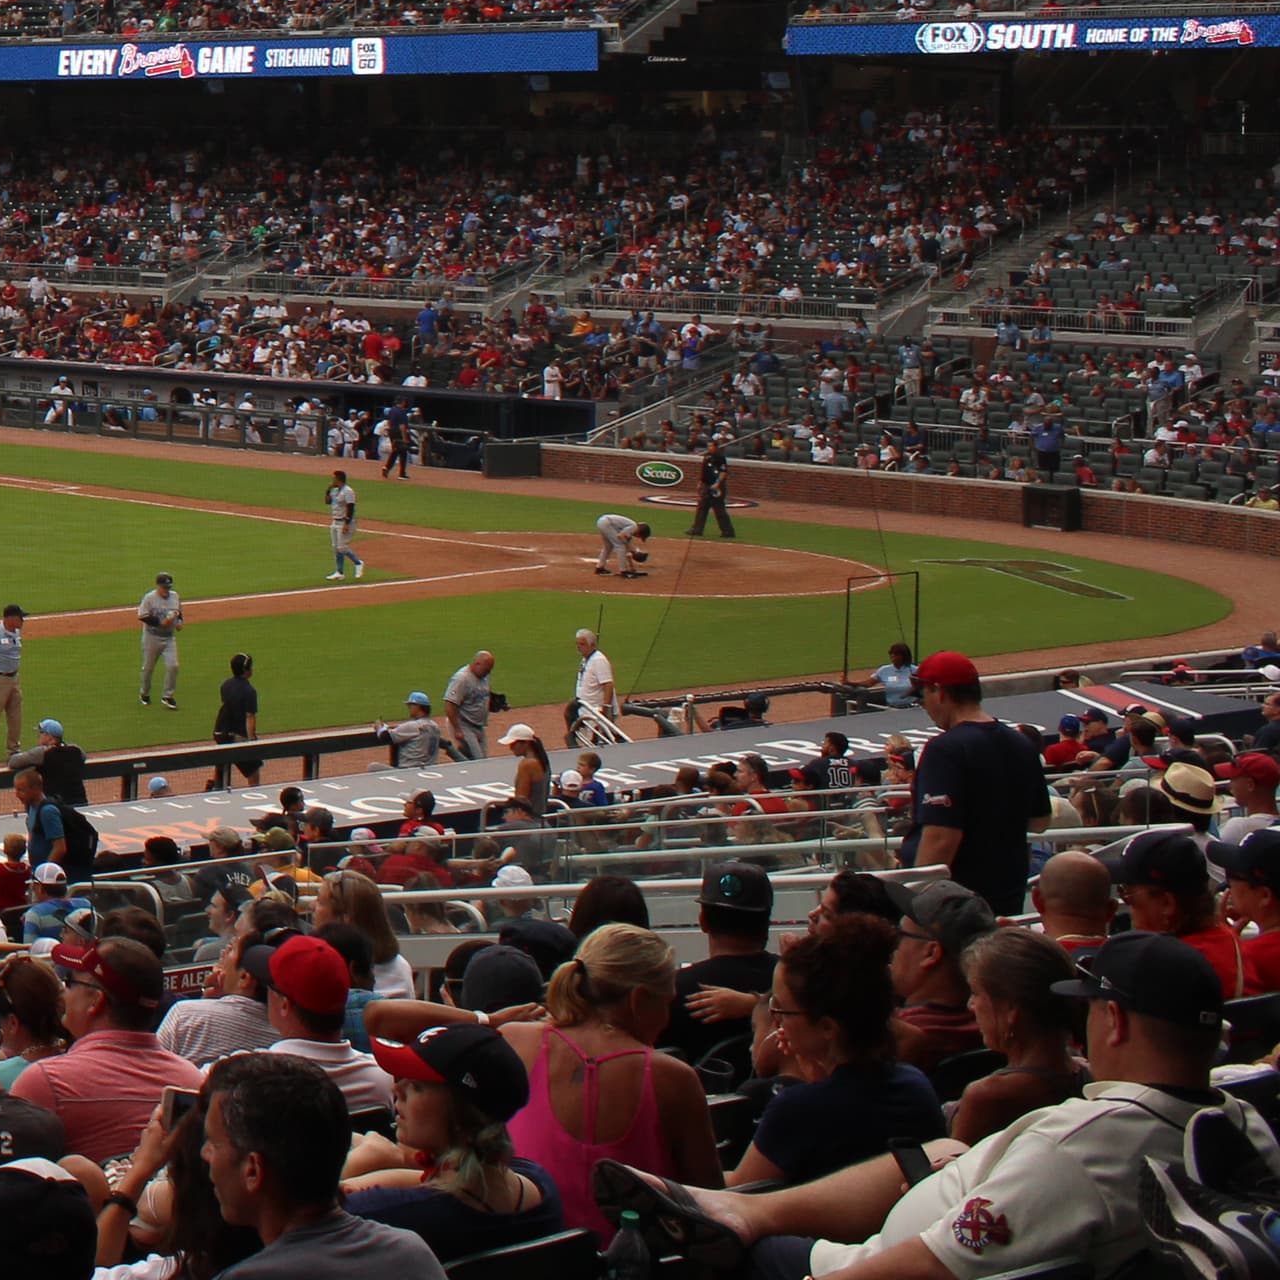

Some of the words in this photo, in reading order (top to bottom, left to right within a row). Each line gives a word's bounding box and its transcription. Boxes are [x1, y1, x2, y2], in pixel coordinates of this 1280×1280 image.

[931, 25, 968, 43] FOX
[1086, 27, 1127, 43] HOME
[1130, 27, 1149, 42] OF
[1152, 26, 1179, 42] THE
[58, 49, 118, 76] EVERY
[197, 45, 256, 74] GAME
[265, 47, 330, 68] STREAMING
[332, 47, 349, 67] ON
[357, 43, 377, 53] FOX
[642, 466, 678, 480] Scotts
[380, 770, 444, 784] TO
[827, 767, 852, 788] 10
[163, 975, 178, 990] BE
